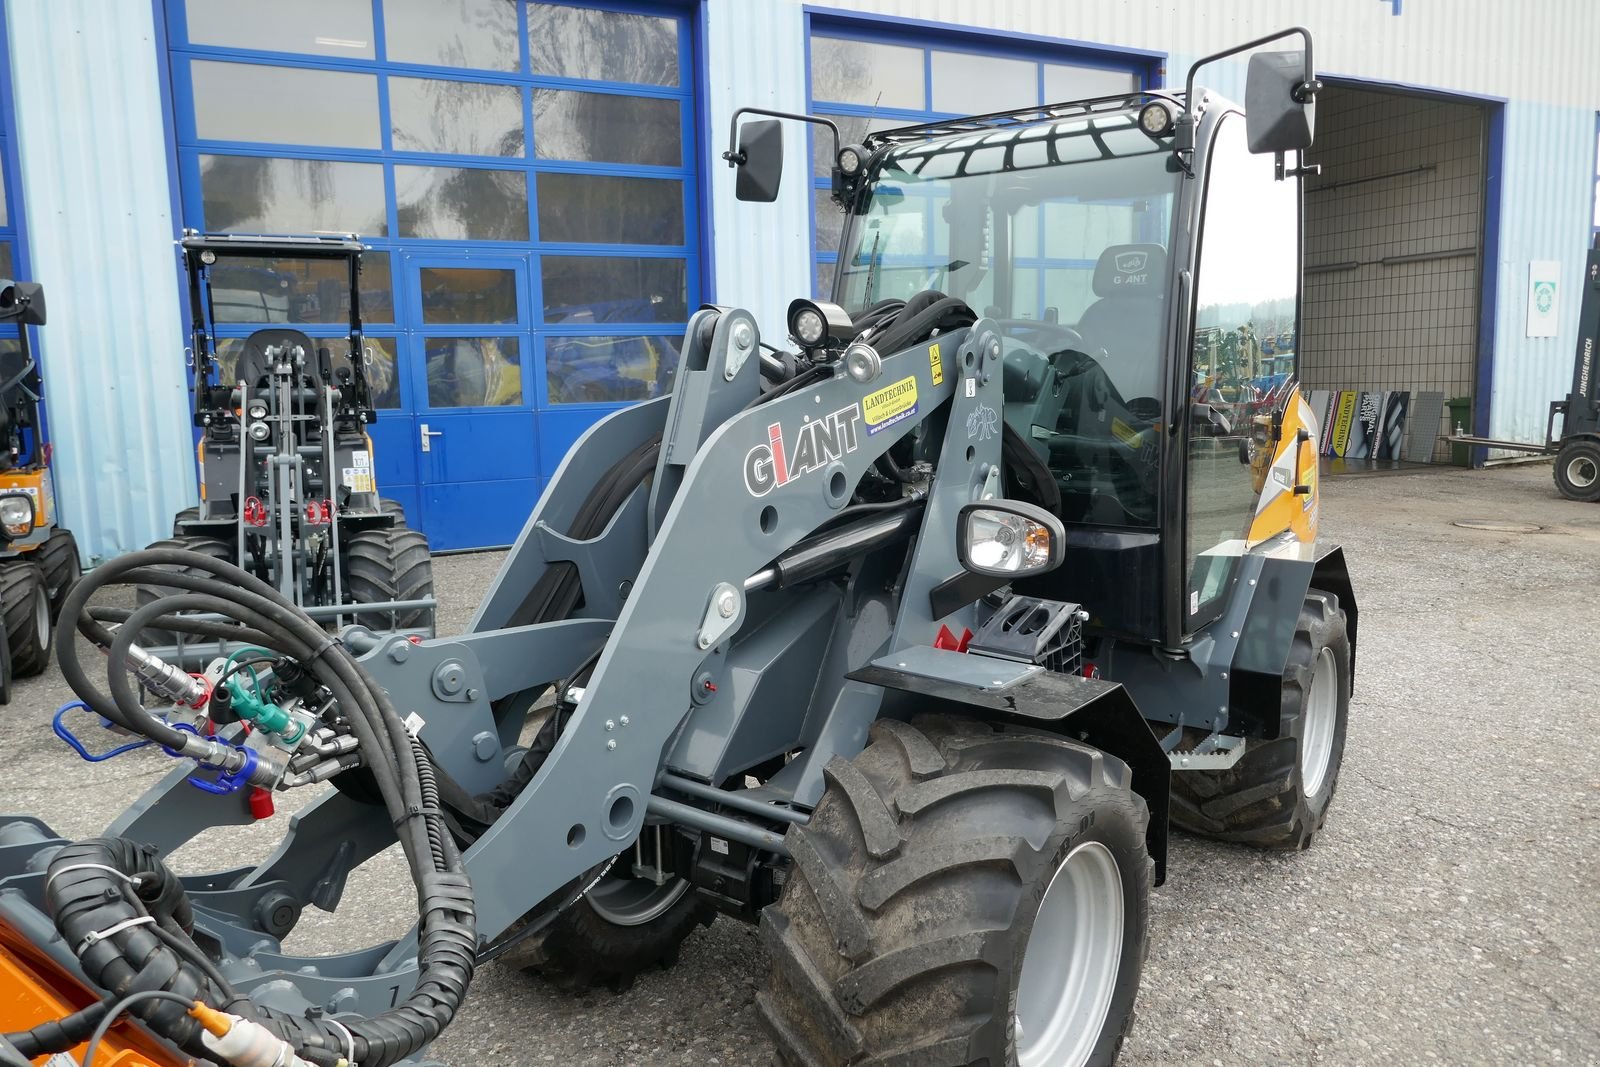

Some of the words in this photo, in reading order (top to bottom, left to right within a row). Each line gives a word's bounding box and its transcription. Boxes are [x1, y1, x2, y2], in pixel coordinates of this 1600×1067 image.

[1113, 273, 1148, 285] GANT
[1580, 338, 1592, 397] JUNGHEINRICH
[865, 380, 914, 410] LANDTECHNIK
[1359, 395, 1368, 422] PARTS
[1336, 394, 1353, 449] LANDTECHNIK
[1366, 394, 1380, 435] ORIGINAL
